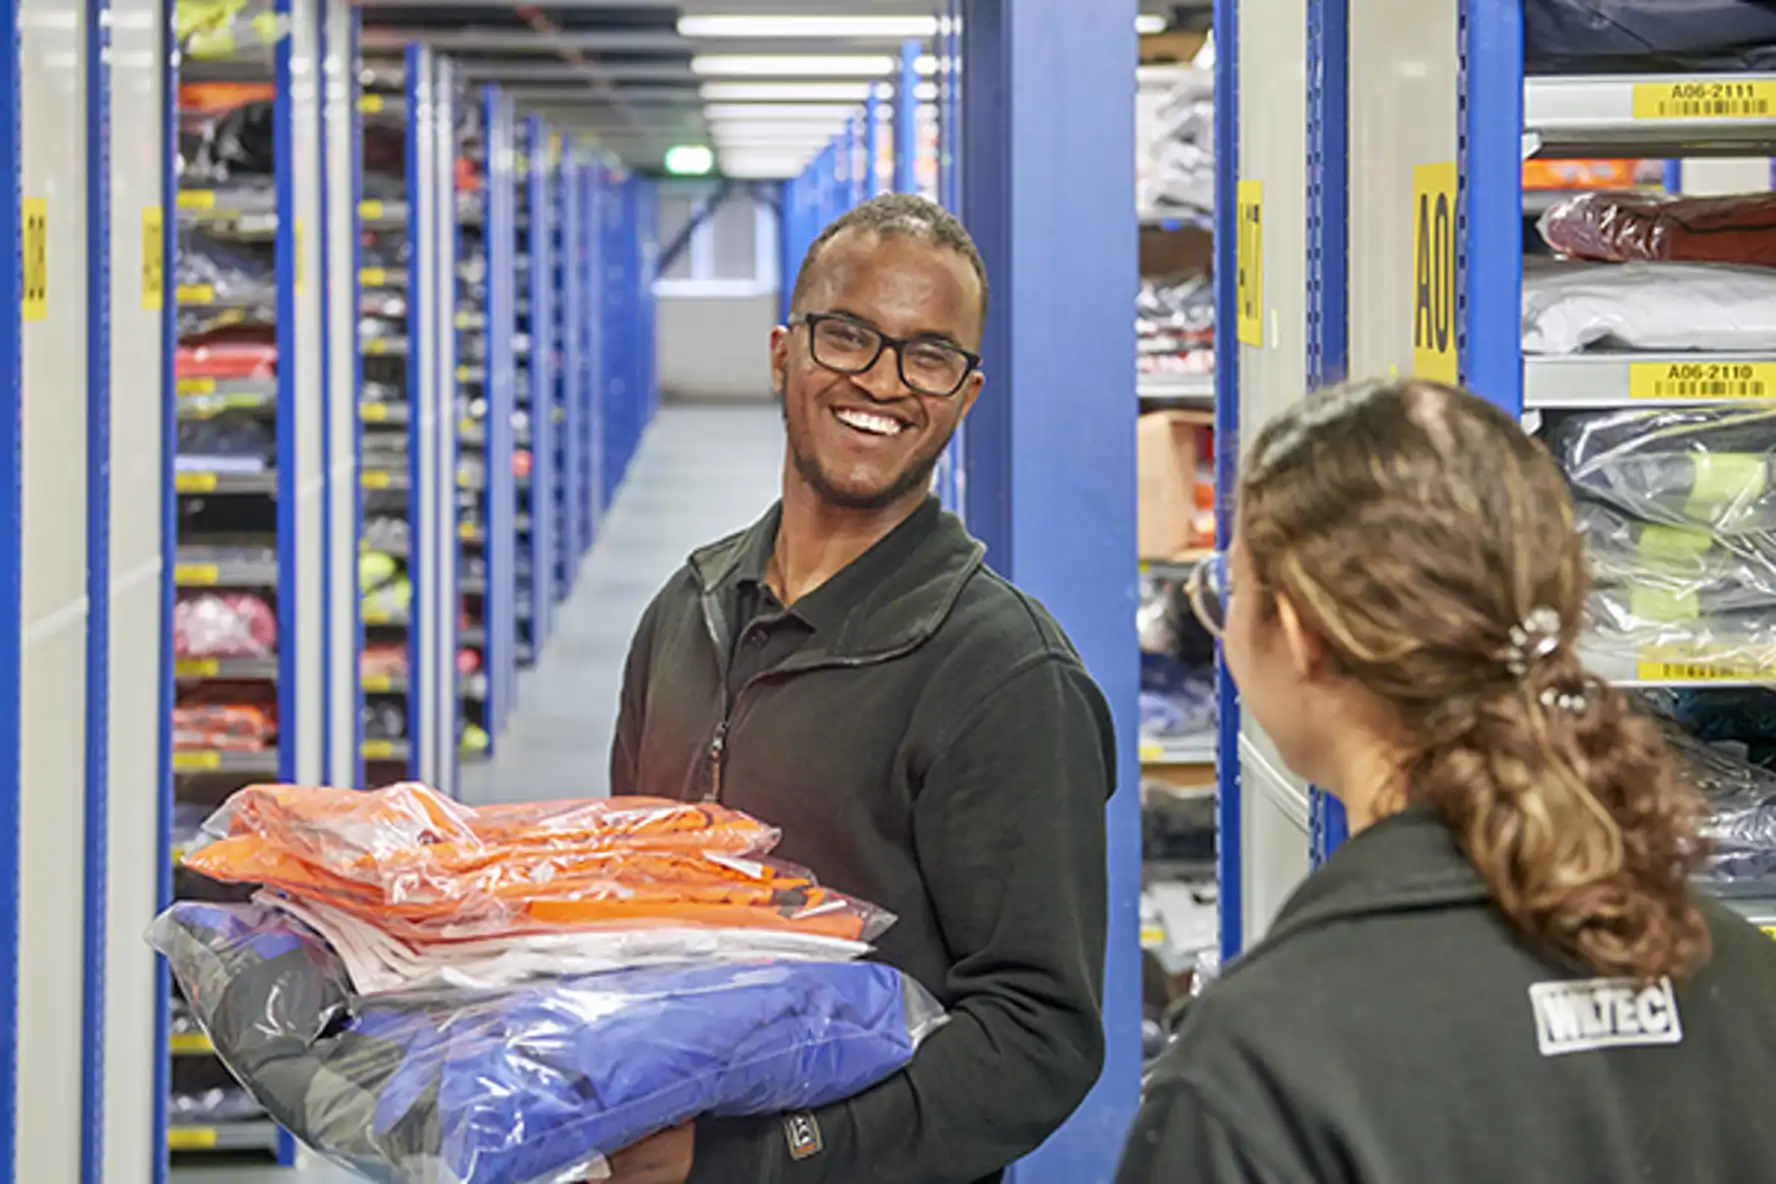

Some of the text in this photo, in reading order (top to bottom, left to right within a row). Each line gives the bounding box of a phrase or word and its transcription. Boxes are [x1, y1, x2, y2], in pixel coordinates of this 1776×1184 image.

[1671, 84, 1754, 98] A06-2111
[1414, 191, 1457, 353] A0
[1668, 364, 1754, 380] A06-2110
